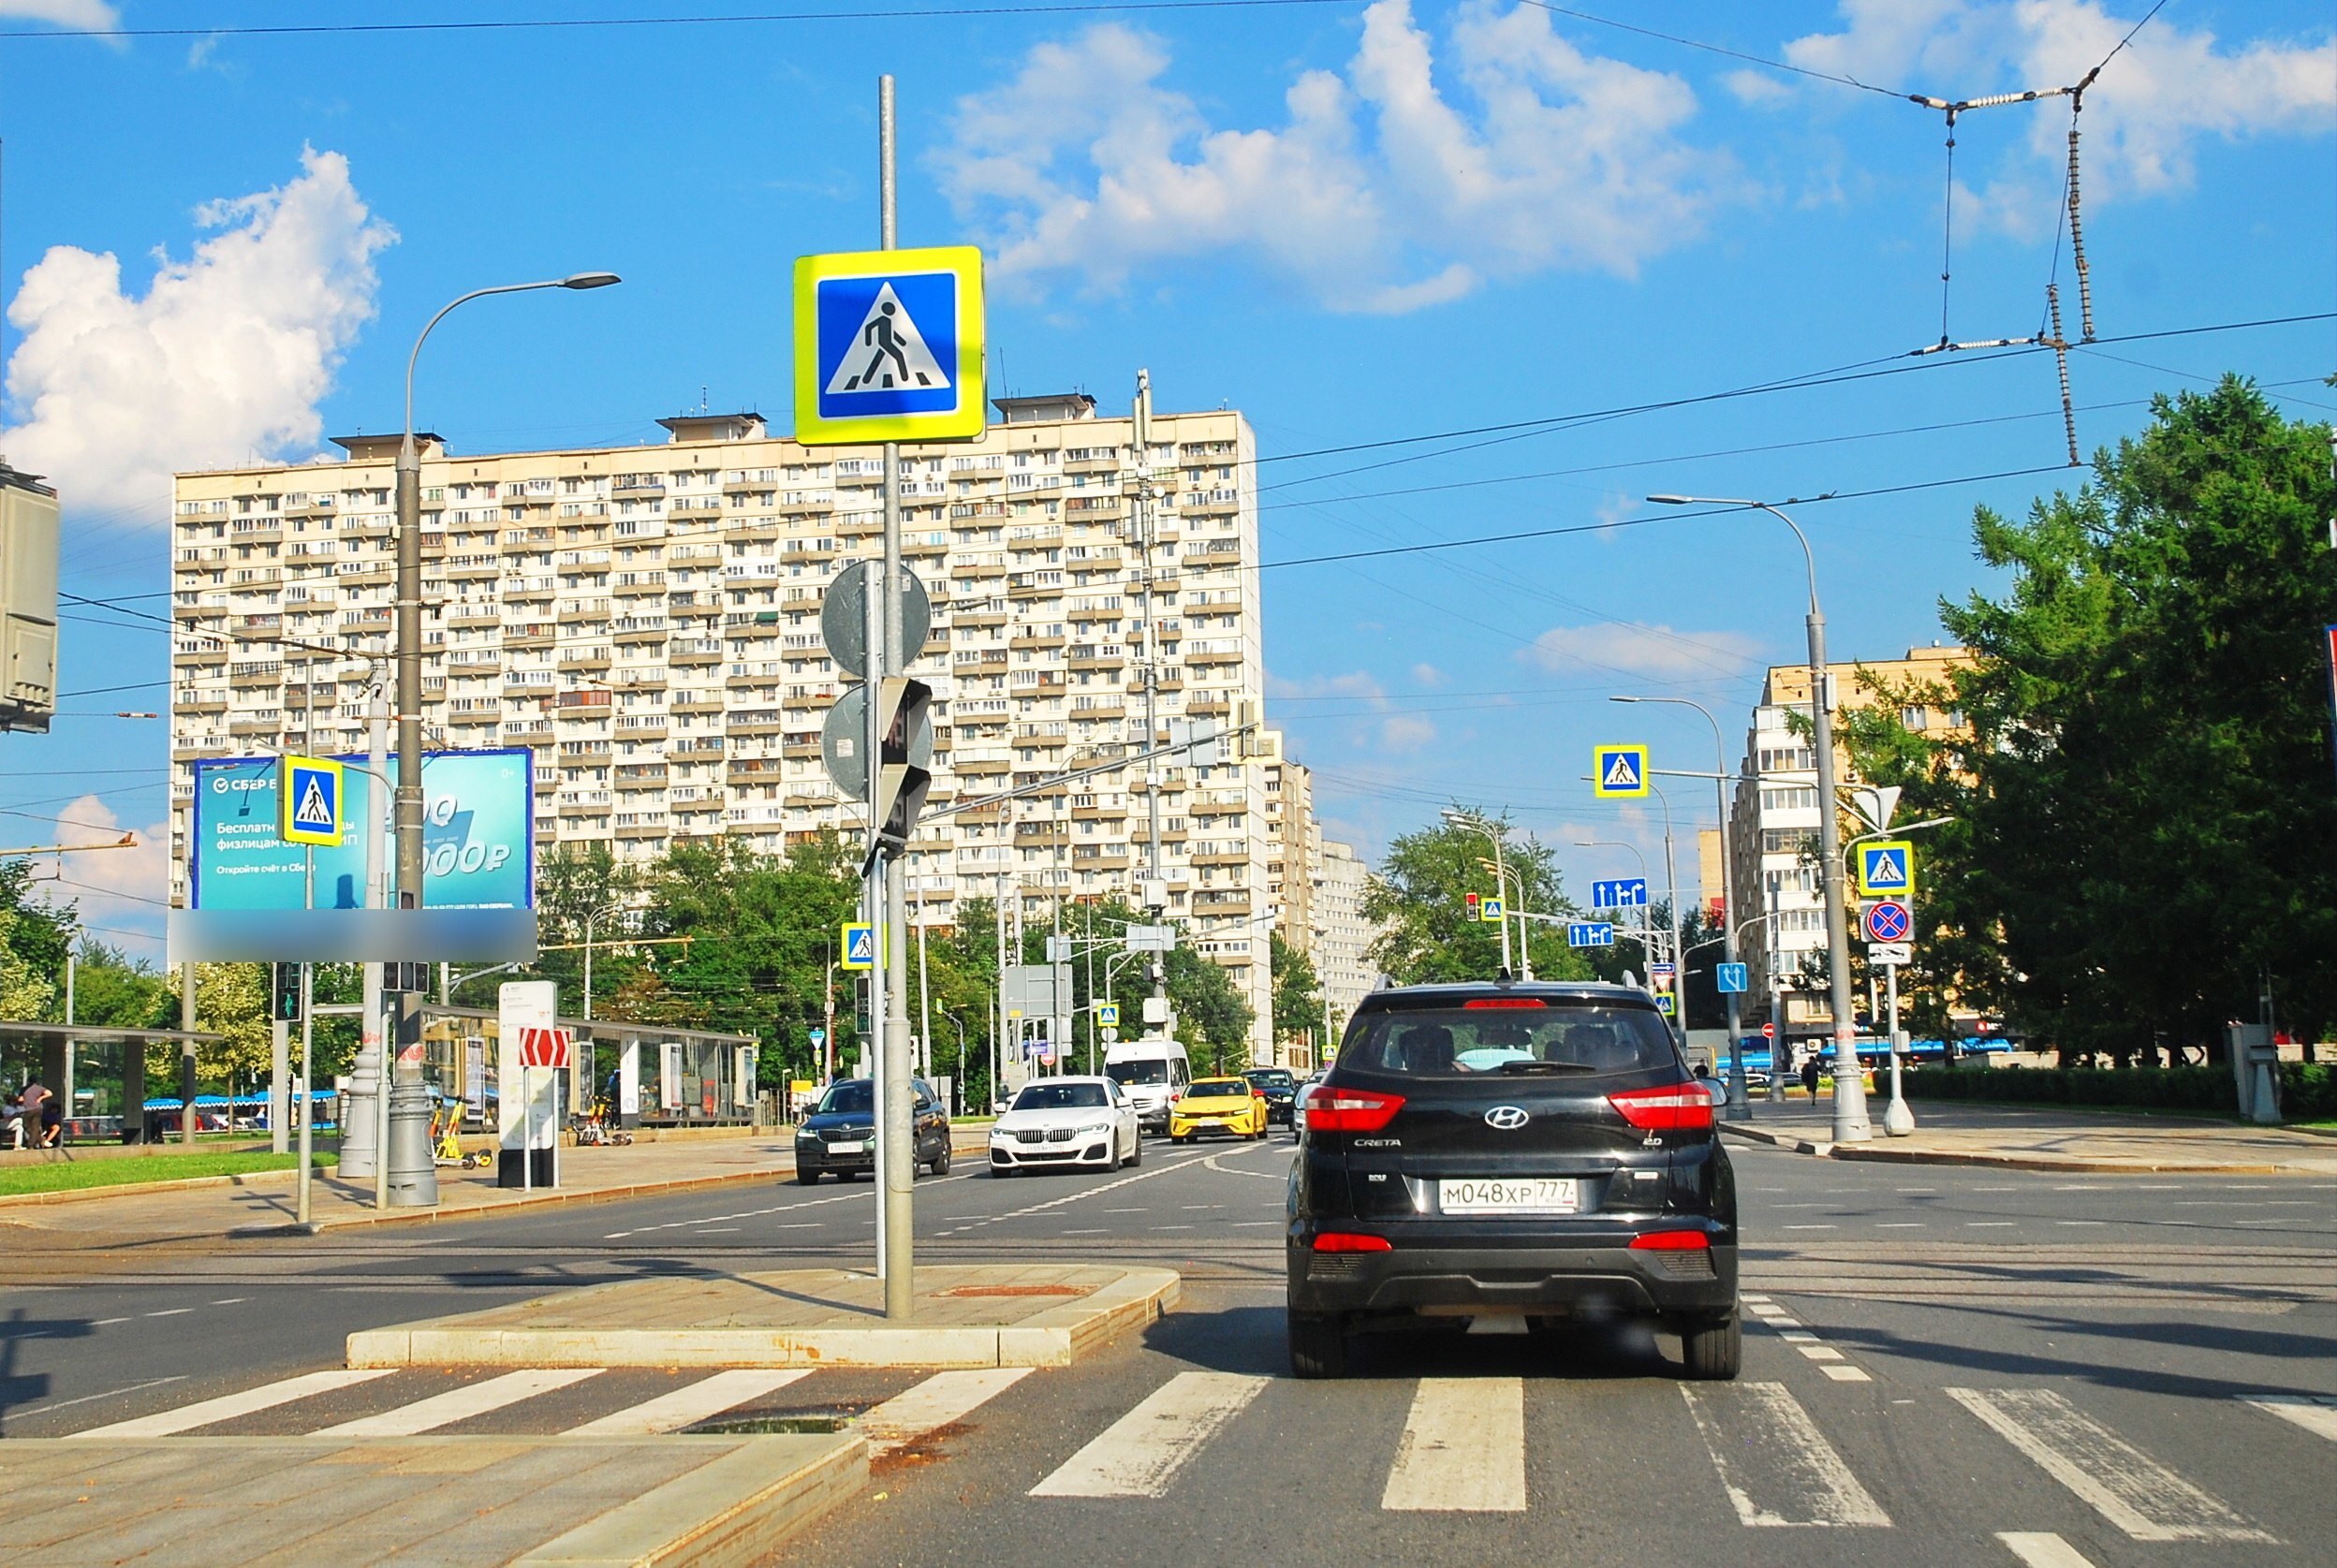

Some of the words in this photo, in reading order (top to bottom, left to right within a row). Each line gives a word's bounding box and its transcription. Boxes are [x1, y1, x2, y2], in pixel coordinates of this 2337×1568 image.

[501, 768, 515, 779] 0+
[231, 779, 267, 791] СБЕР
[216, 822, 276, 834] Бесплатн
[216, 837, 280, 852] физлицам
[216, 864, 259, 875] Откройте
[260, 864, 280, 872] счёт
[288, 862, 316, 872] Сбе
[1354, 1138, 1402, 1147] CRETA
[1447, 1182, 1532, 1204] М048ХР
[1536, 1181, 1569, 1197] 777
